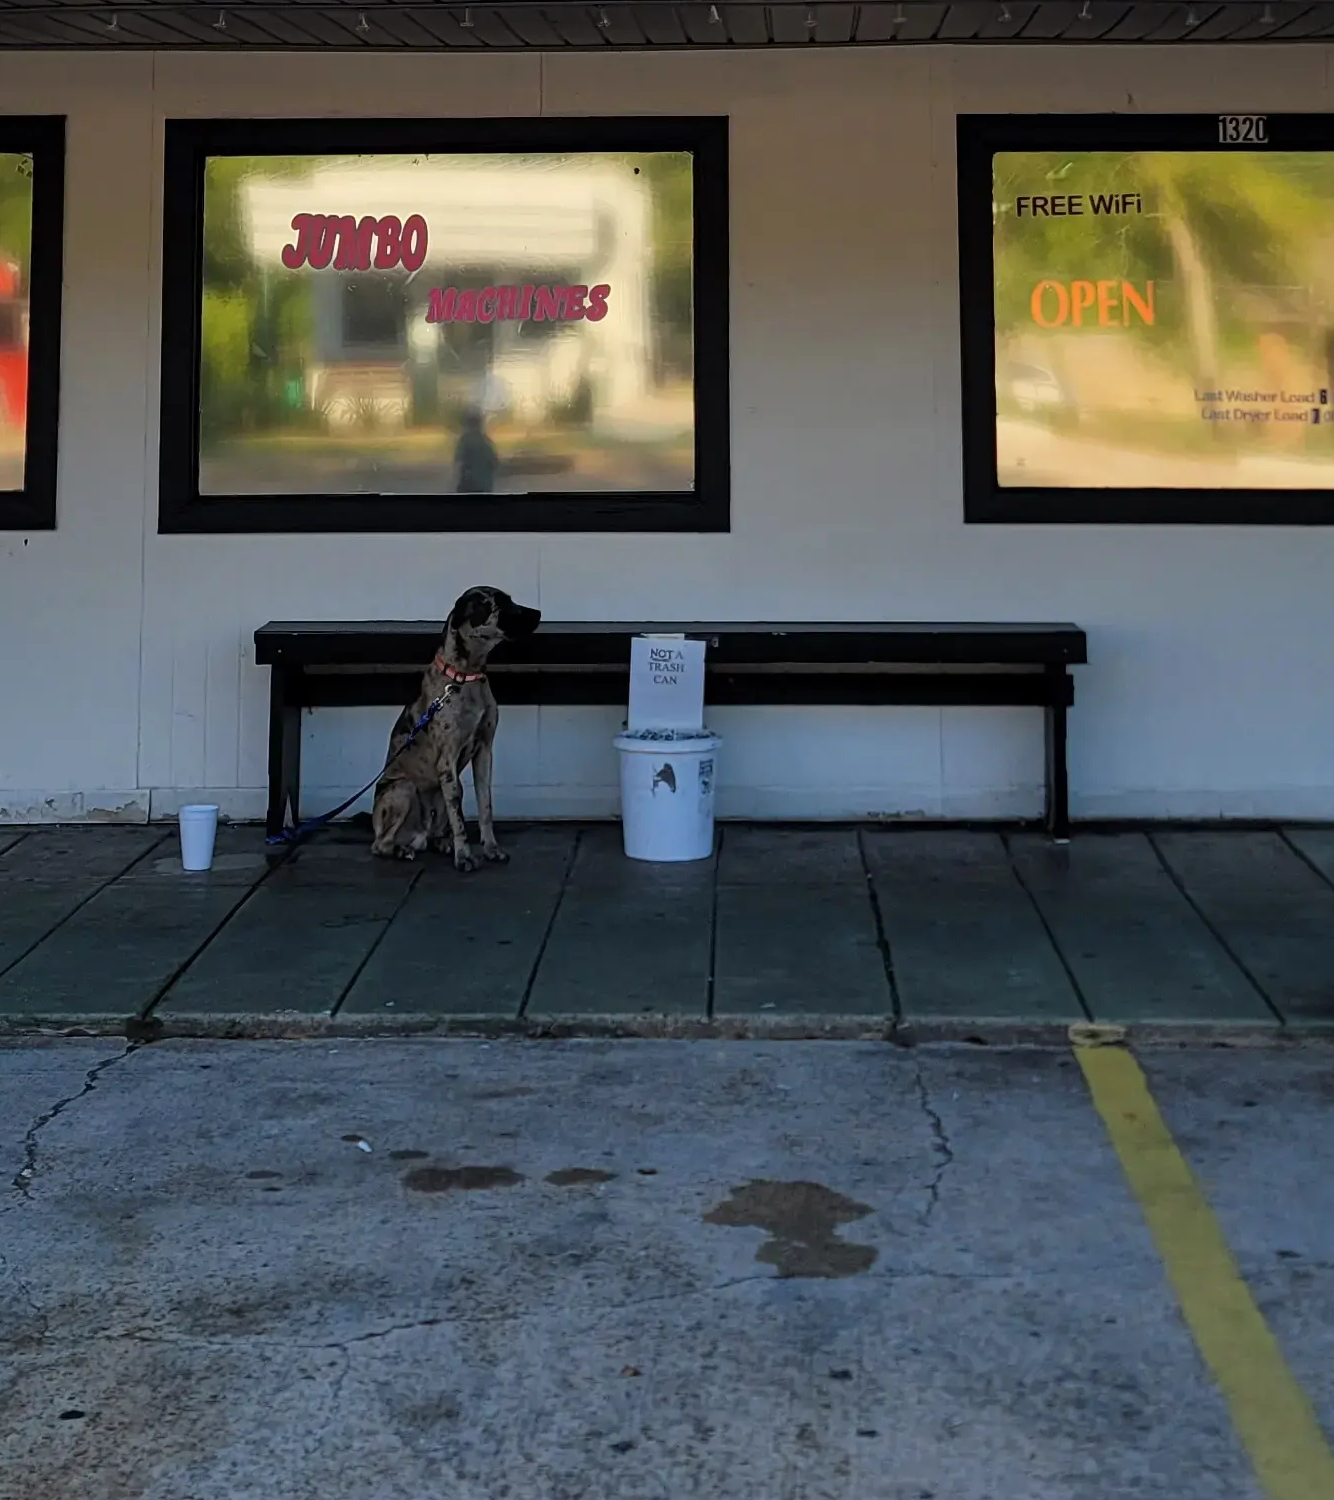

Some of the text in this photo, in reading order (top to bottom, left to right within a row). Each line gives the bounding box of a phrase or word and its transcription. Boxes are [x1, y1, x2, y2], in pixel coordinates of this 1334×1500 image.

[1218, 116, 1267, 142] 1320
[1016, 193, 1142, 217] FREE WiFi
[282, 213, 429, 272] JUMBO
[425, 284, 612, 324] MACHINES
[1031, 279, 1155, 329] OPEN
[1225, 389, 1278, 403] Washer
[650, 648, 684, 660] NOT A
[648, 661, 685, 673] TRASH
[653, 675, 677, 685] CAN
